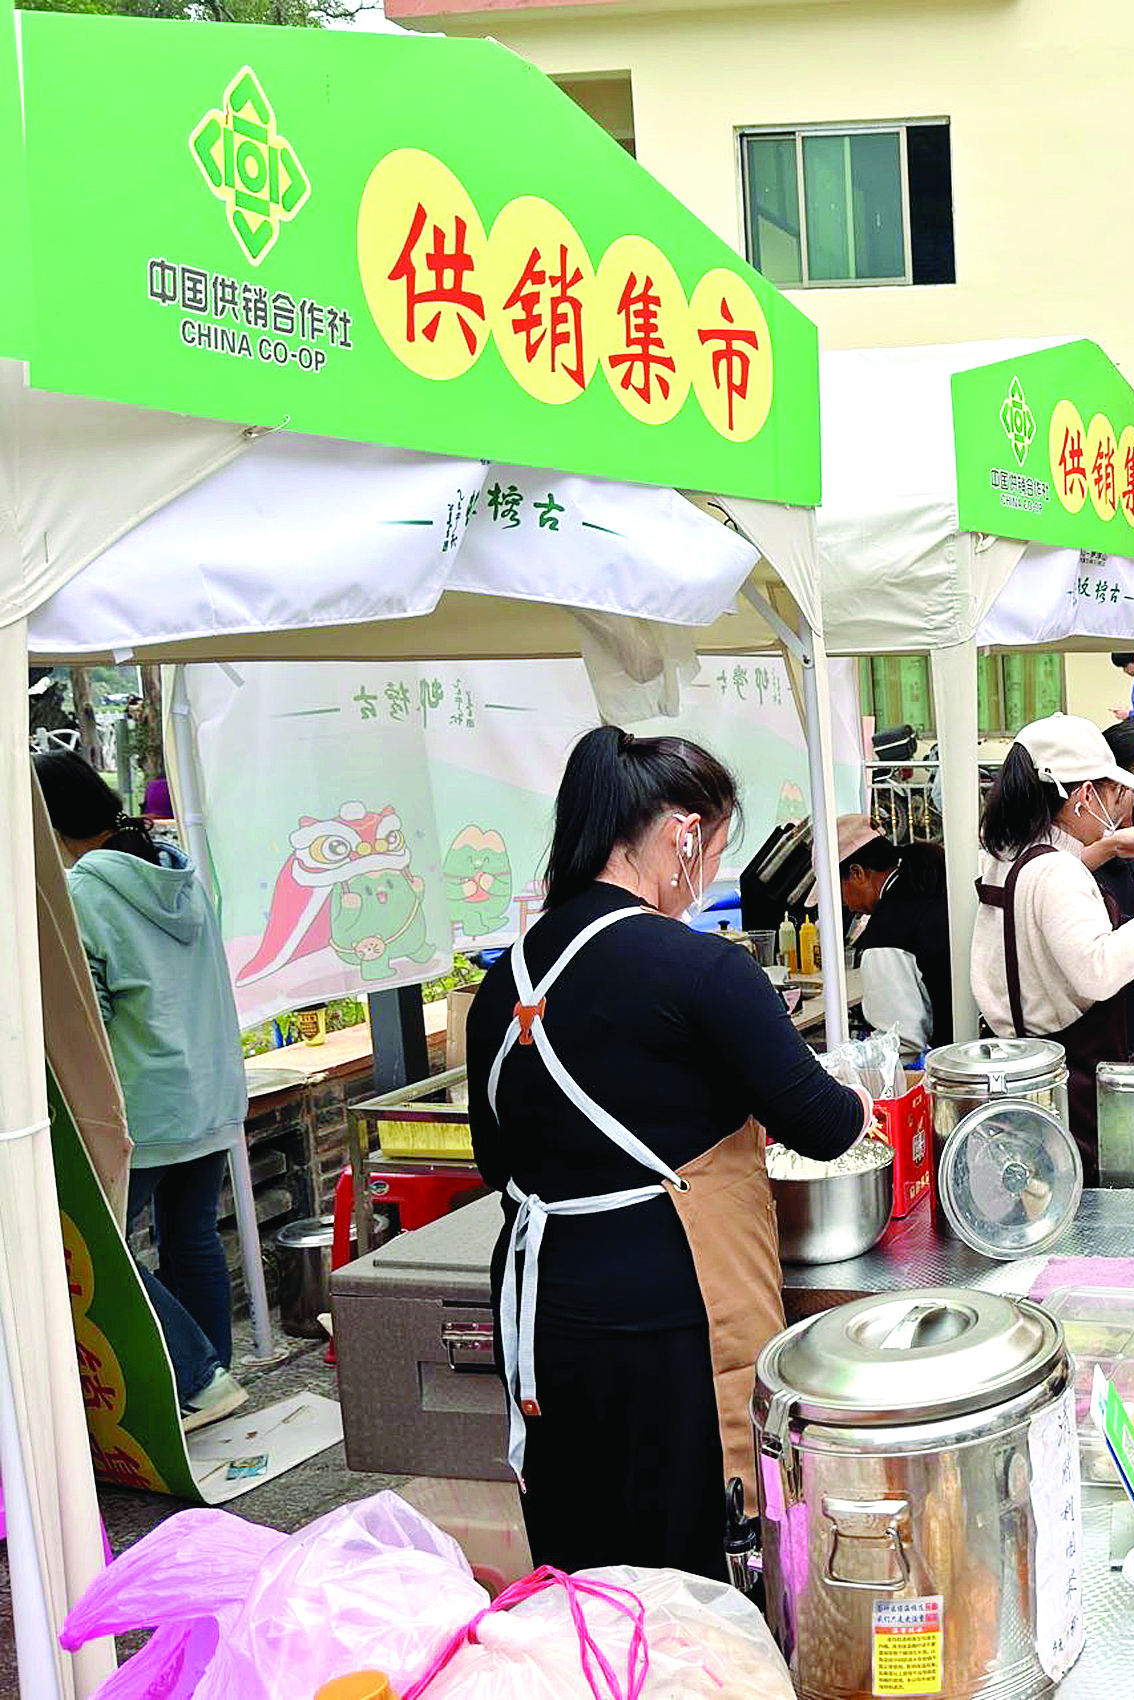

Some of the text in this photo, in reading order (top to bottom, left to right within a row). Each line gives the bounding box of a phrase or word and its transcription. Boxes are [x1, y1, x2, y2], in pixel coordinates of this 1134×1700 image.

[148, 259, 353, 350] 中国供销合作社
[180, 320, 327, 371] CHINA CO-OP
[388, 202, 758, 430] 供销集市
